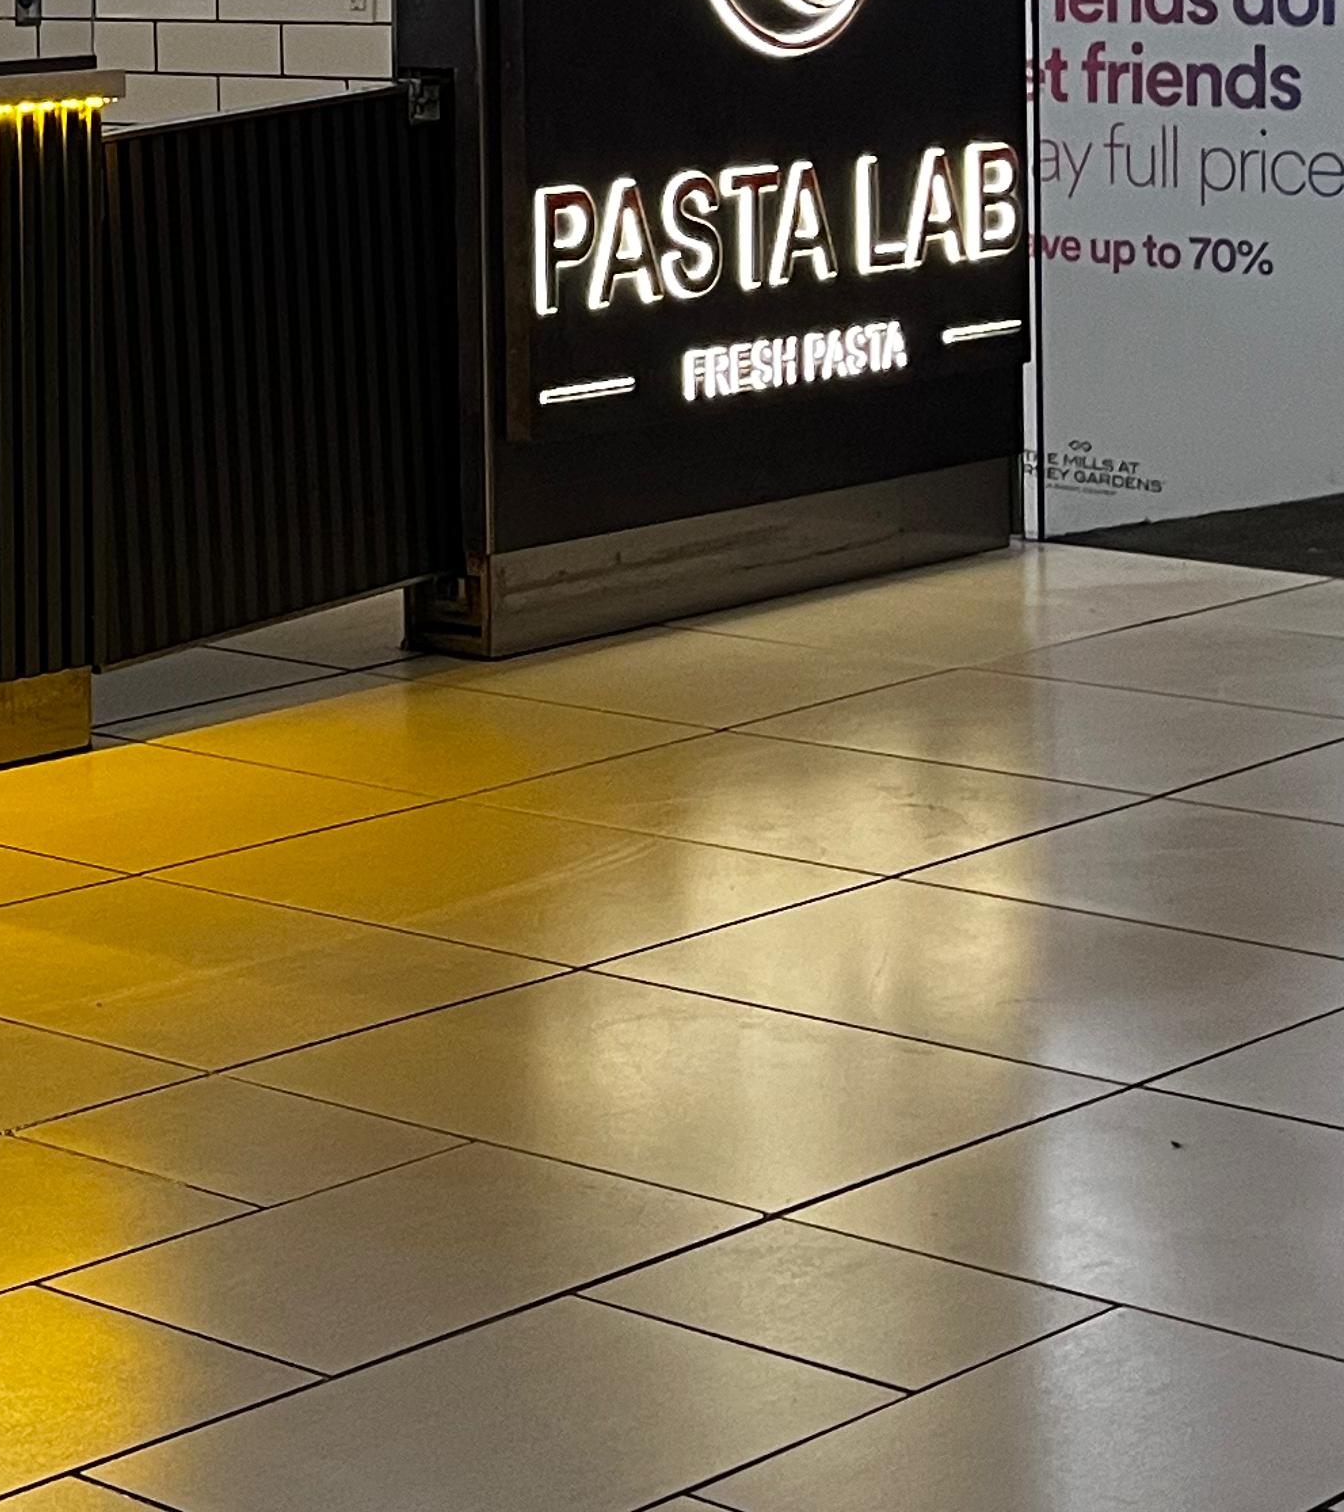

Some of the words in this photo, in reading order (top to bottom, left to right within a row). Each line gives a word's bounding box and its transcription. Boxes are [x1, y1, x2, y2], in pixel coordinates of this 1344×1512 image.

[1081, 41, 1301, 111] friends
[1040, 139, 1092, 199] ay
[1103, 122, 1178, 188] full
[1201, 129, 1344, 207] price
[534, 160, 838, 316] PASTA
[854, 141, 1024, 276] LAB
[1090, 238, 1136, 274] up
[1142, 234, 1181, 269] to
[1189, 237, 1274, 276] 70%
[681, 335, 797, 401] FRESH
[802, 320, 908, 384] PASTA
[1063, 454, 1114, 473] MILLS
[1118, 460, 1140, 475] AT
